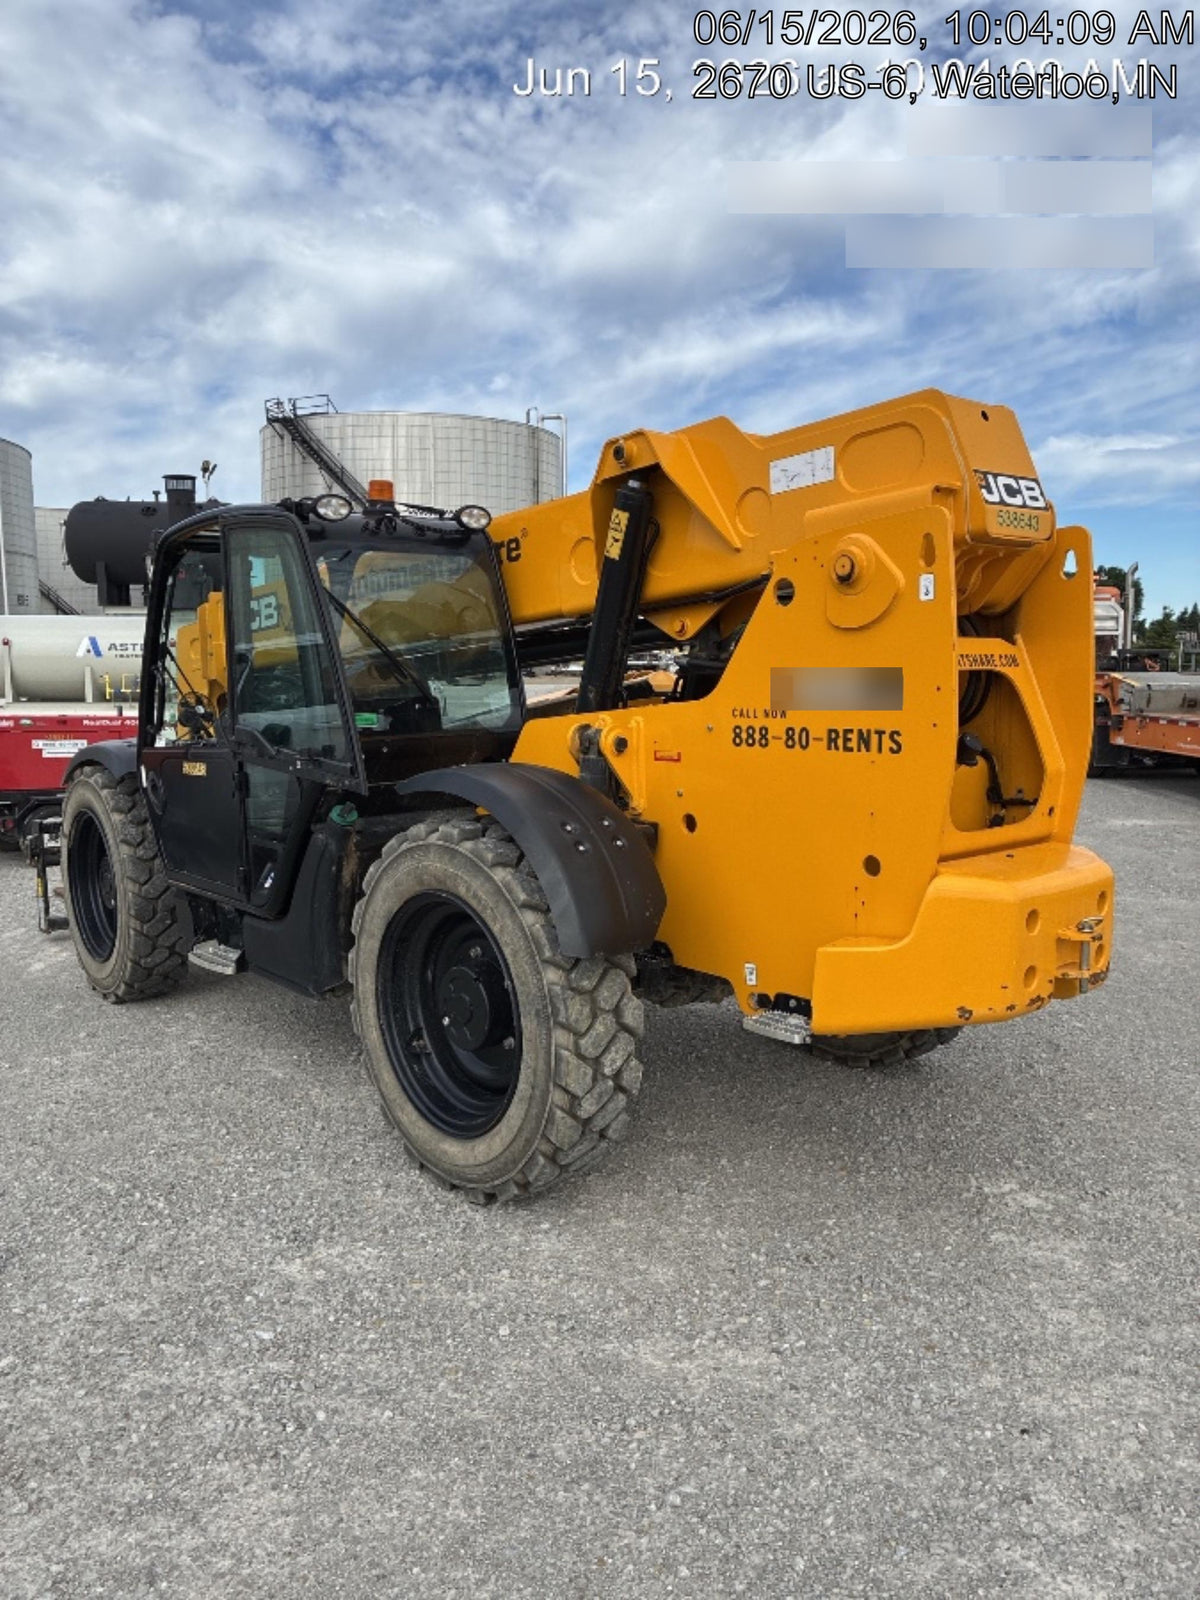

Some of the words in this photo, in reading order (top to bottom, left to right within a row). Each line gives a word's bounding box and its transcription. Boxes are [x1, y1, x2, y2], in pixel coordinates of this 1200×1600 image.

[981, 474, 1047, 508] JCB
[731, 706, 759, 719] CALL
[731, 725, 903, 754] 888-80-RENTS
